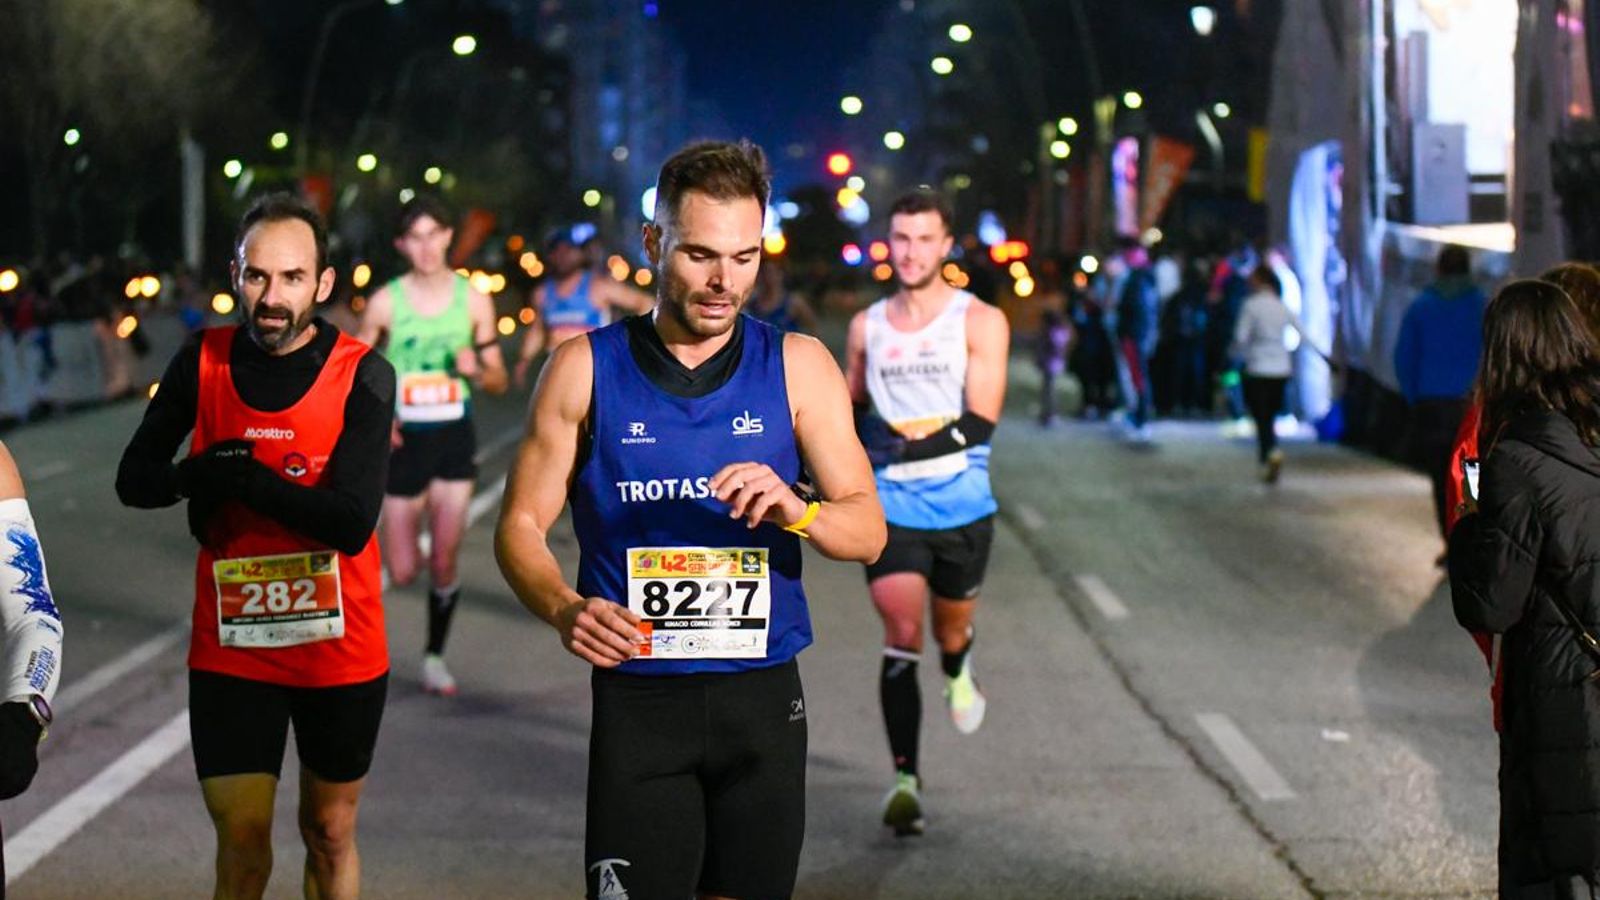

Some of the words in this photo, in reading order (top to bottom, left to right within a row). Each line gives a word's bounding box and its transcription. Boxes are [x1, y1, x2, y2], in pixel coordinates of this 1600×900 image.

[661, 553, 688, 572] 42
[241, 578, 318, 614] 282
[642, 580, 759, 617] 8227
